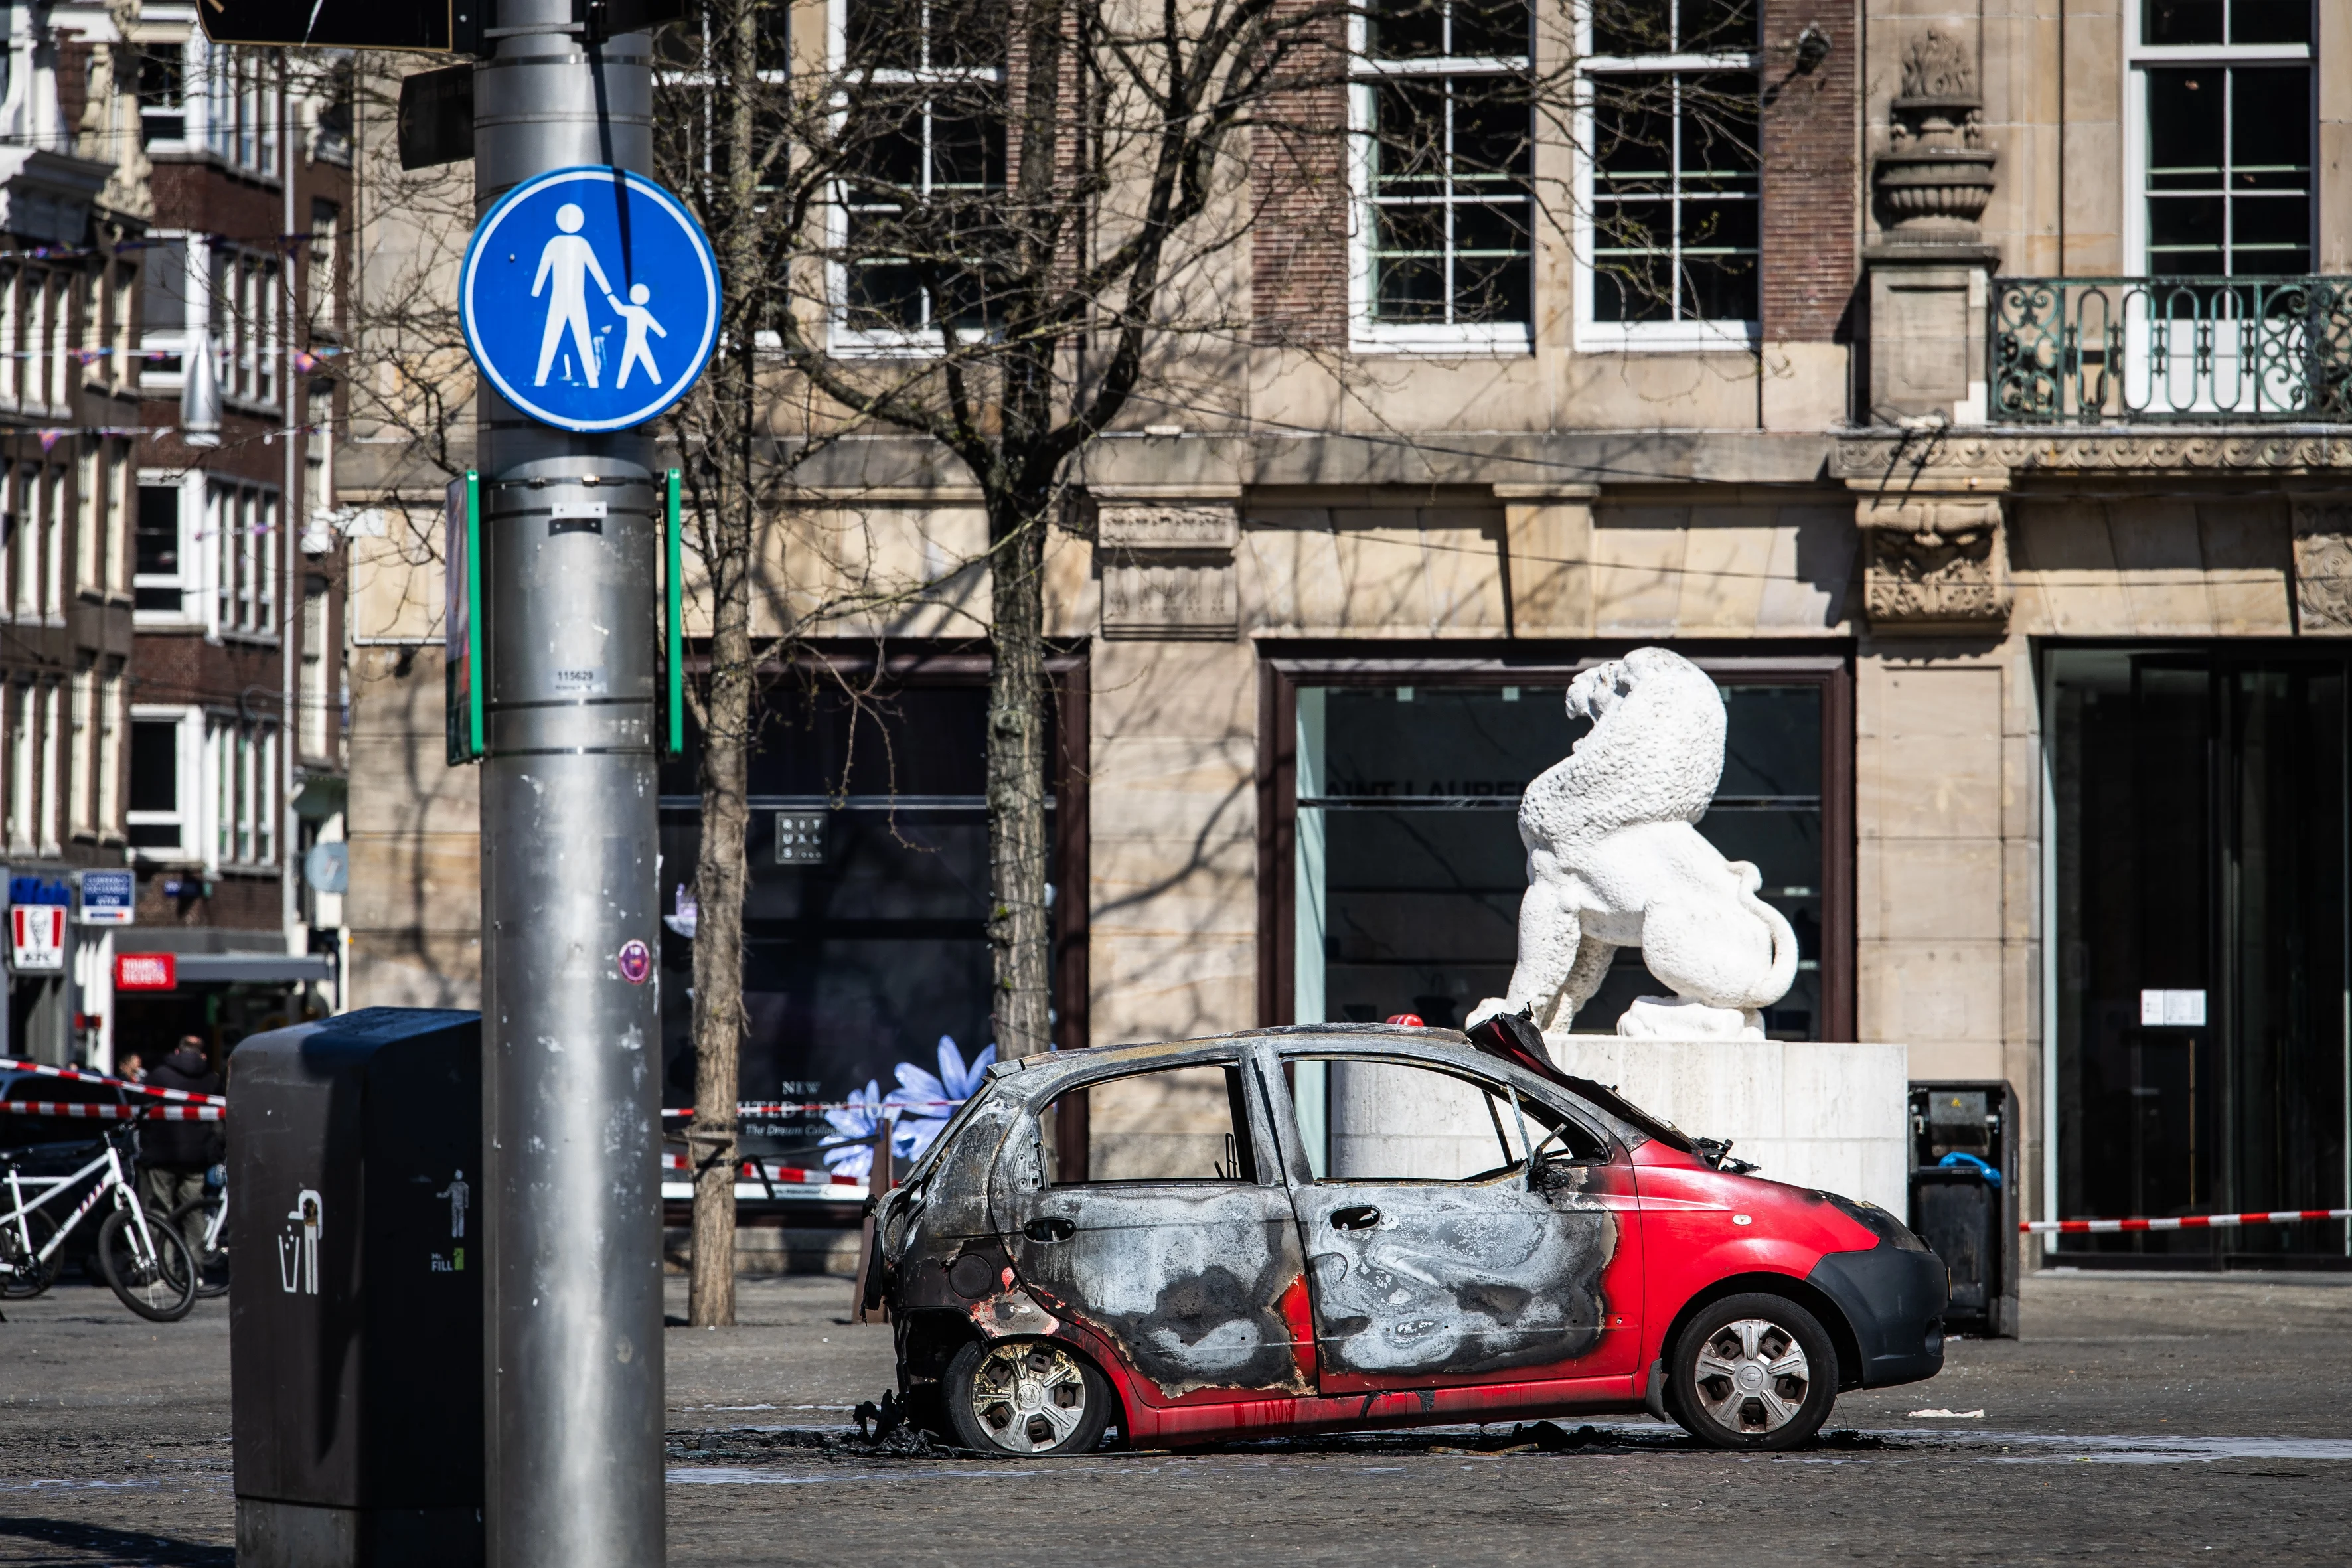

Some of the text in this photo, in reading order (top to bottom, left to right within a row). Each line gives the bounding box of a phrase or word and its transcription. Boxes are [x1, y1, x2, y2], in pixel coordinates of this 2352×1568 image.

[1326, 779, 1396, 796] AINT
[782, 1081, 821, 1095] NEW
[745, 1123, 765, 1136] The
[767, 1123, 803, 1137] Dream
[432, 1261, 453, 1271] FILL
